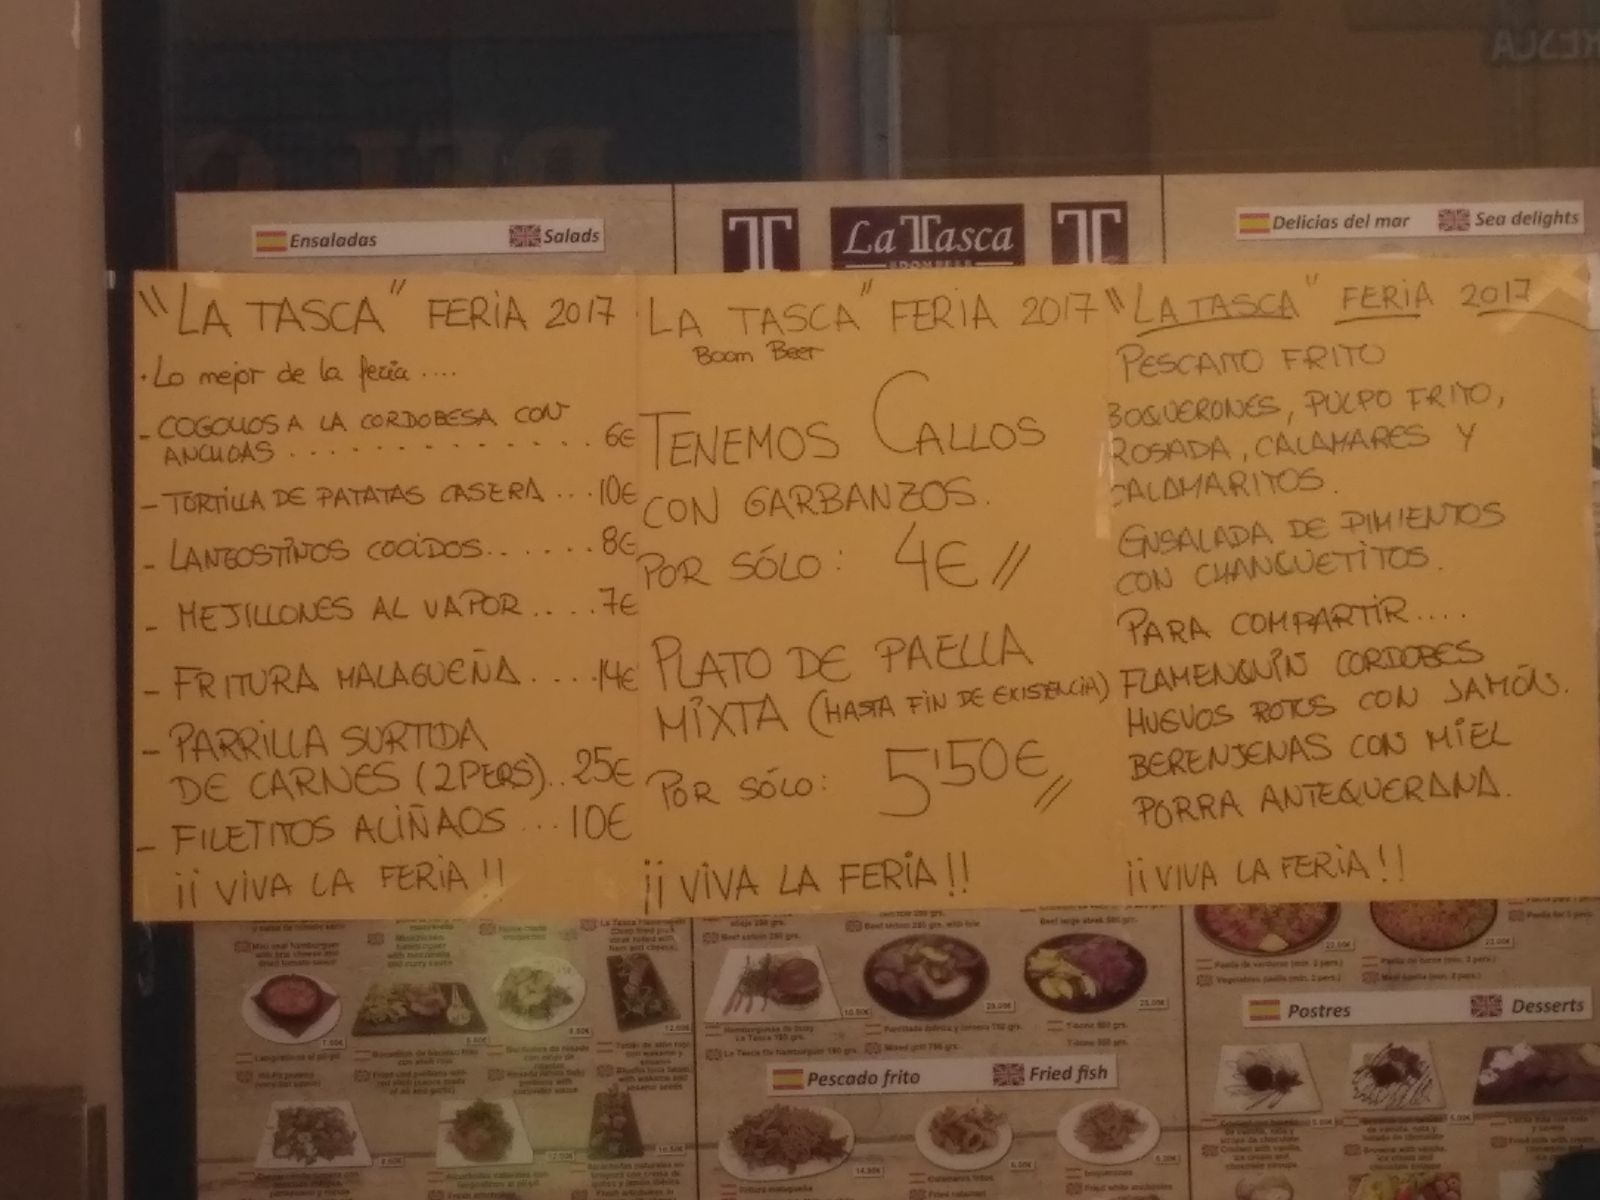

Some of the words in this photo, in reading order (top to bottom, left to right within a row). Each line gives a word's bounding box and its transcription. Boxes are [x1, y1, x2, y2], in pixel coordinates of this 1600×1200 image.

[290, 233, 377, 249] Ensaladas
[543, 228, 600, 244] Salads
[842, 220, 896, 255] La
[900, 214, 1014, 254] Tasca
[1273, 215, 1338, 230] Delicias
[1344, 214, 1370, 229] del
[1375, 216, 1410, 228] mar
[1475, 211, 1506, 227] Sea
[1511, 208, 1580, 229] delights
[427, 290, 528, 331] FERIA
[544, 295, 616, 330] 2017
[649, 296, 703, 339] LA
[891, 288, 998, 333] FERIA
[1020, 292, 1098, 326] 2017
[1342, 279, 1434, 314] FERIA
[1460, 277, 1532, 310] 2017
[199, 361, 266, 395] mejor
[276, 361, 306, 385] de
[319, 356, 344, 383] la
[358, 354, 411, 393] feria
[691, 345, 754, 366] Boom
[1281, 343, 1385, 370] FRITO
[287, 414, 304, 433] A
[319, 411, 348, 432] LA
[360, 407, 498, 430] CORDOBESA
[514, 401, 571, 424] CON
[637, 410, 840, 471] TENEMOS
[872, 369, 1046, 456] CALLOS
[1303, 389, 1392, 417] PULPO
[604, 421, 636, 449] 6€
[1255, 421, 1431, 458] CALAMARES
[1456, 422, 1477, 452] Y
[272, 486, 306, 508] DE
[316, 483, 426, 508] PATATAS
[440, 476, 545, 504] CASERA
[642, 486, 719, 529] CON
[169, 536, 350, 572] LANGOSTINOS
[601, 525, 639, 558] 8€
[1117, 520, 1276, 561] ENSALADA
[1287, 517, 1329, 540] DE
[1340, 501, 1506, 534] PIMIENTOS
[634, 550, 712, 590] POR
[894, 521, 979, 592] 4€
[1114, 568, 1173, 596] CON
[178, 595, 354, 632] MEJILLONES
[371, 595, 409, 622] AL
[423, 588, 523, 619] VAPOR
[598, 586, 639, 616] 7€
[1116, 607, 1212, 647] PARA
[173, 662, 320, 701] FRITURA
[336, 648, 521, 690] MALAGUEÑA
[650, 635, 772, 694] PLATO
[786, 644, 852, 683] DE
[874, 623, 1034, 673] PAELLA
[655, 690, 789, 743] MIXTA
[905, 690, 947, 715] FIN
[956, 687, 984, 708] DE
[1127, 703, 1235, 738] HUEVOS
[1249, 693, 1338, 724] ROTOS
[1358, 685, 1419, 711] CON
[168, 719, 329, 763] PARRILLA
[340, 717, 488, 760] SURTIDA
[1128, 730, 1333, 784] BERENJENAS
[1349, 731, 1407, 759] CON
[1425, 717, 1512, 752] MIEL
[169, 772, 229, 806] DE
[249, 761, 400, 801] CARNES
[571, 746, 635, 788] 25€
[645, 769, 721, 811] POR
[171, 814, 335, 855] FILETITOS
[572, 802, 632, 841] 10€
[1132, 789, 1244, 829] PORRA
[311, 867, 355, 897] LA
[779, 864, 821, 896] LA
[1236, 857, 1271, 885] LA
[1288, 1003, 1351, 1018] Postres
[1511, 998, 1585, 1014] Desserts
[808, 1070, 878, 1088] Pescado
[883, 1070, 921, 1091] frito
[1029, 1065, 1073, 1081] Fried
[1077, 1063, 1108, 1085] fish
